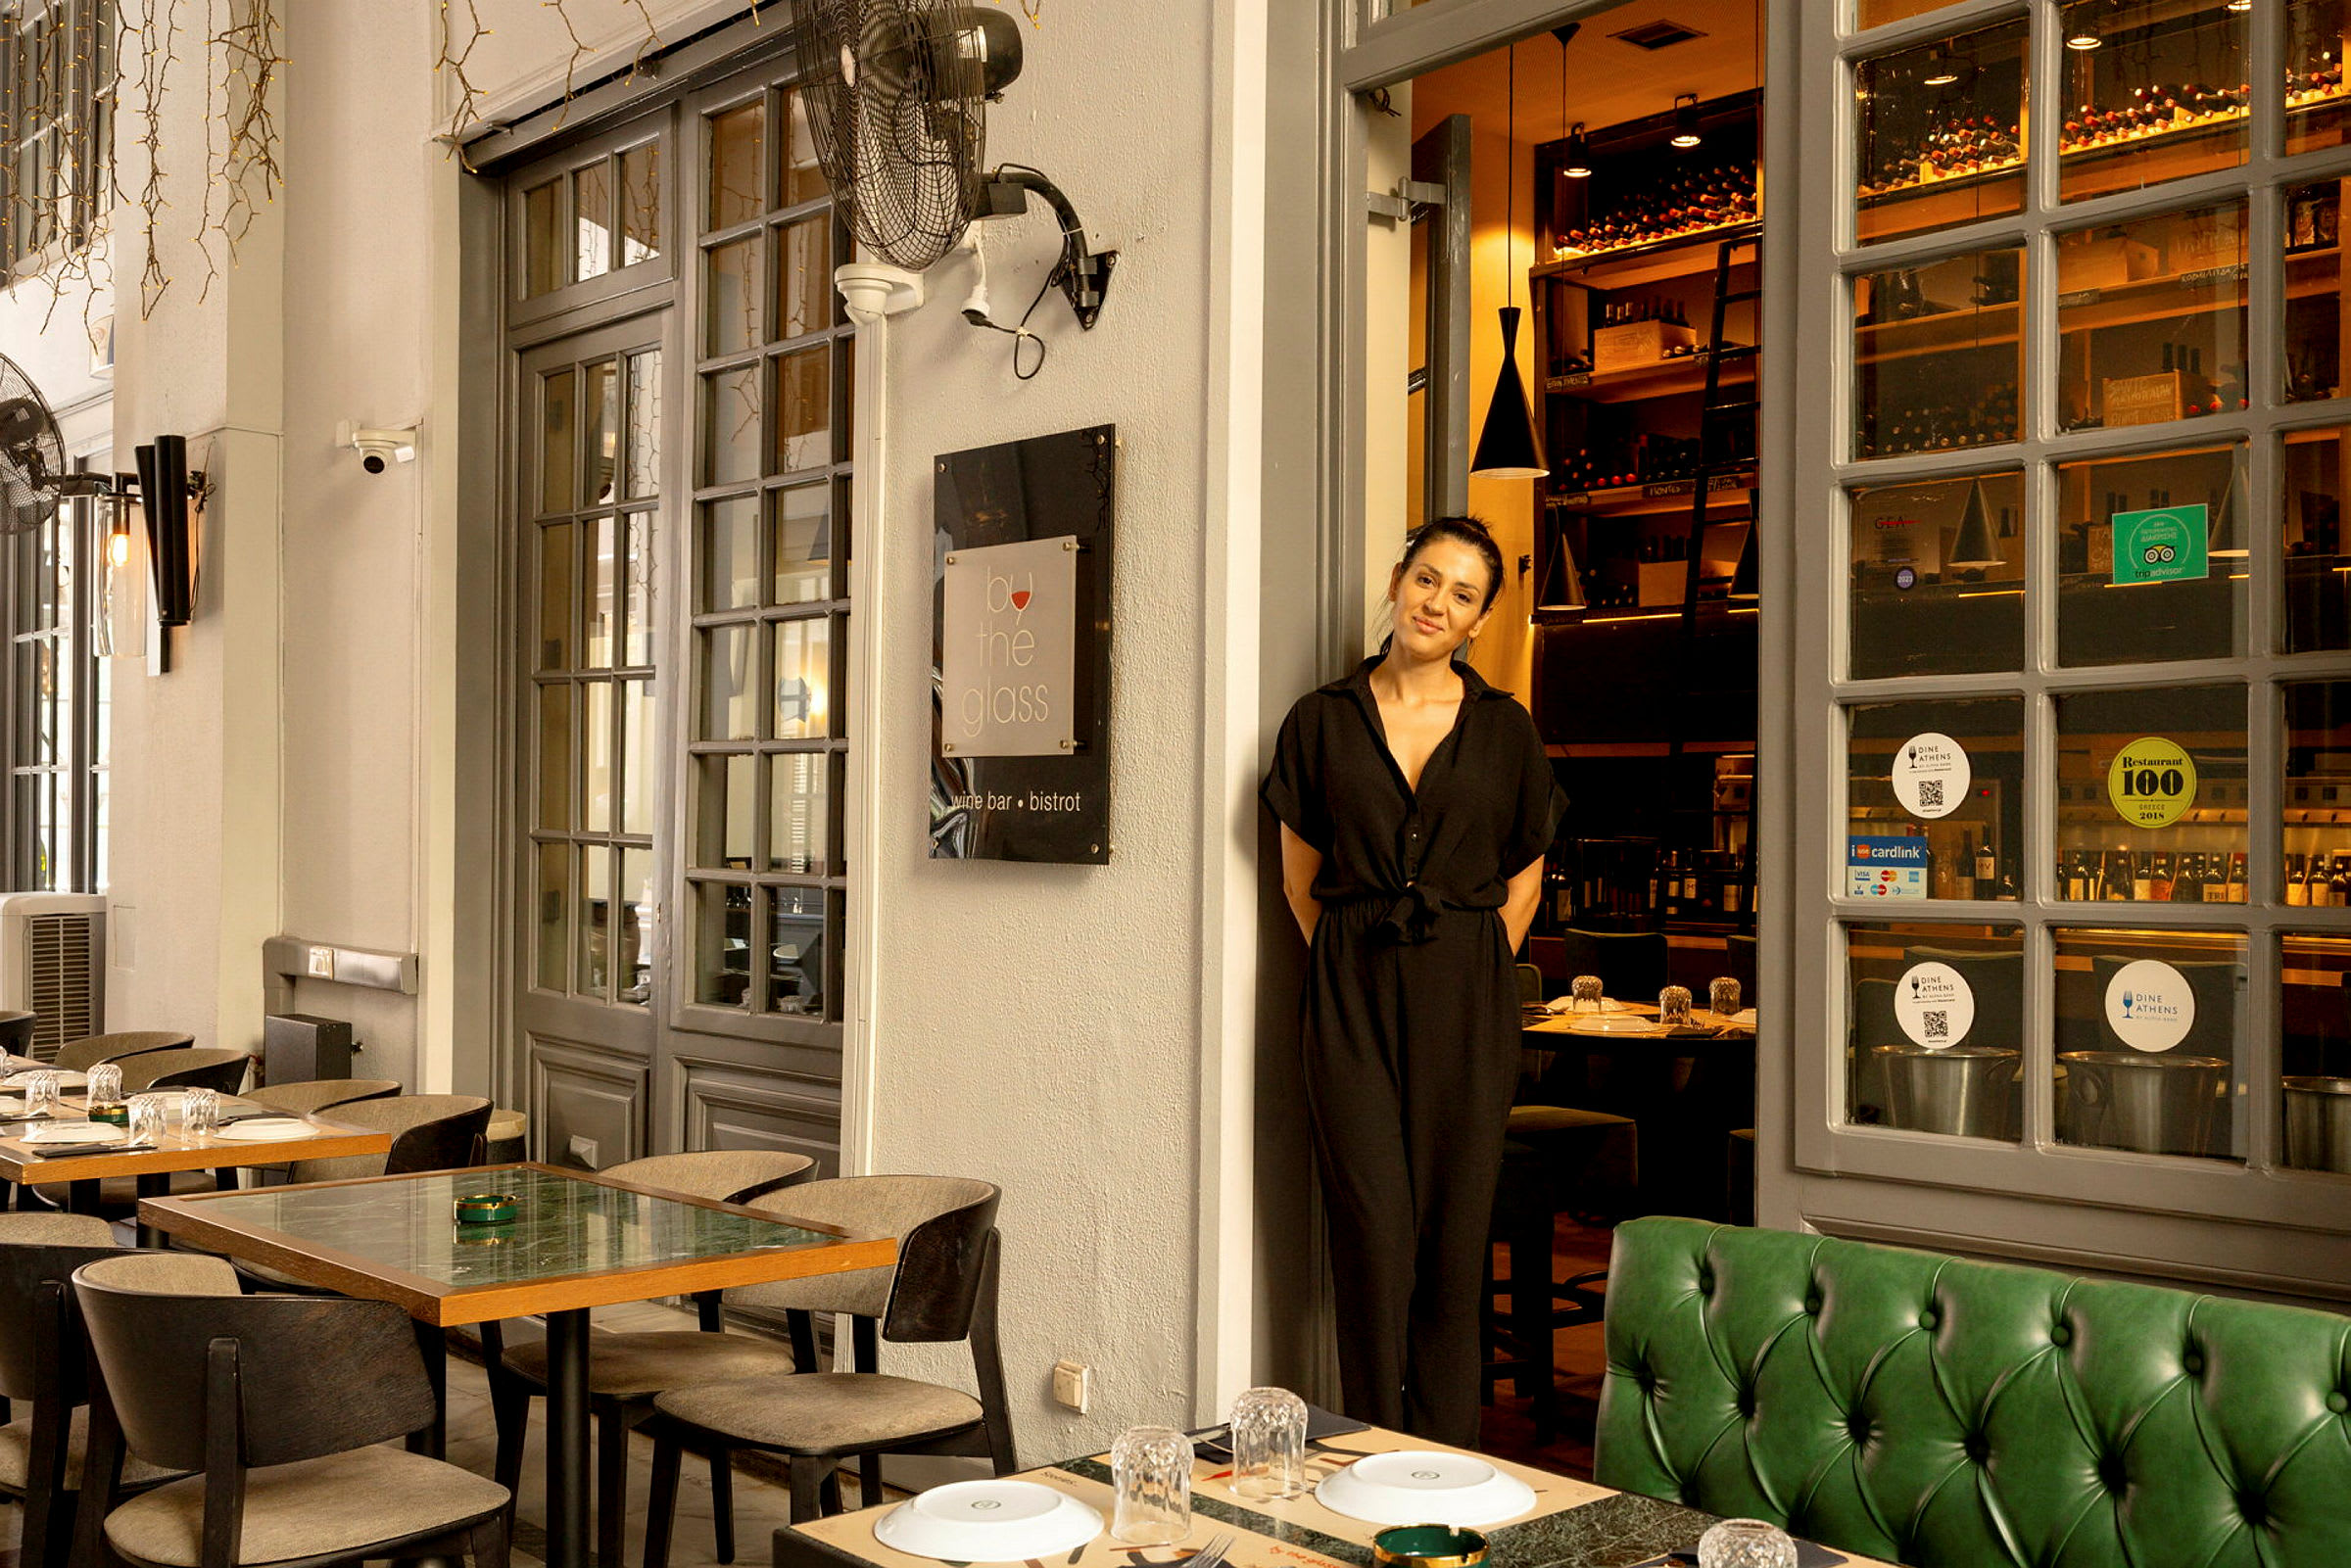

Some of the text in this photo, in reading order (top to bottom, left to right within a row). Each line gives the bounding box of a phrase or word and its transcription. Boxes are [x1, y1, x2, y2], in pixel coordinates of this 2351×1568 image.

[2135, 567, 2183, 579] tripadvisor
[985, 565, 1032, 626] by
[977, 619, 1035, 667] the
[961, 676, 1049, 737] glass
[1918, 745, 1939, 754] DINE
[1919, 752, 1951, 762] ATHENS
[2122, 756, 2183, 769] Restaurant
[2121, 769, 2184, 796] 100
[951, 788, 1081, 812] wine bar bistrot
[1871, 845, 1920, 859] cardlink
[1921, 975, 1942, 984] DINE
[1922, 984, 1954, 993] ATHENS
[2135, 993, 2163, 1004] DINE
[2135, 1004, 2178, 1015] ATHENS
